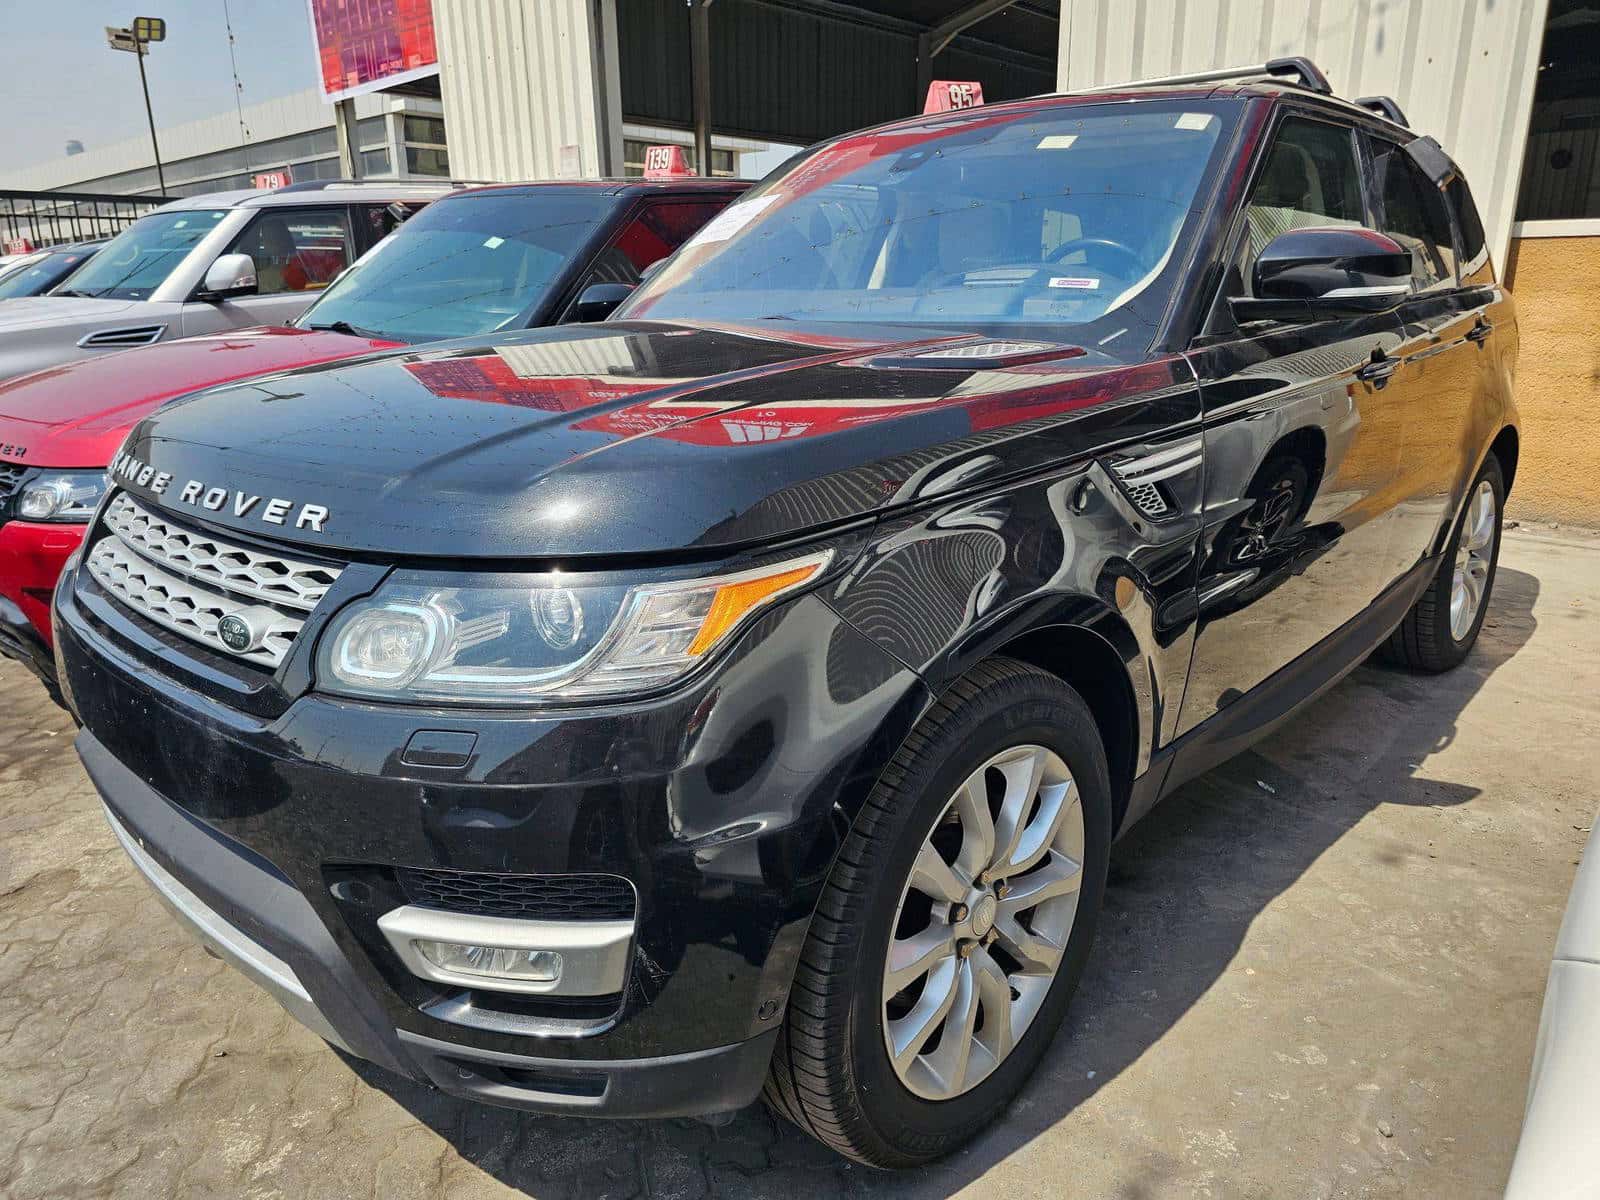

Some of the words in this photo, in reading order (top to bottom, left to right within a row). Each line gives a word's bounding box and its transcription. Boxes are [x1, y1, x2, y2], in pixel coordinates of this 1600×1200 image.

[949, 84, 973, 110] 95
[649, 148, 670, 170] 139
[263, 173, 279, 190] 79
[179, 480, 329, 532] ROVER
